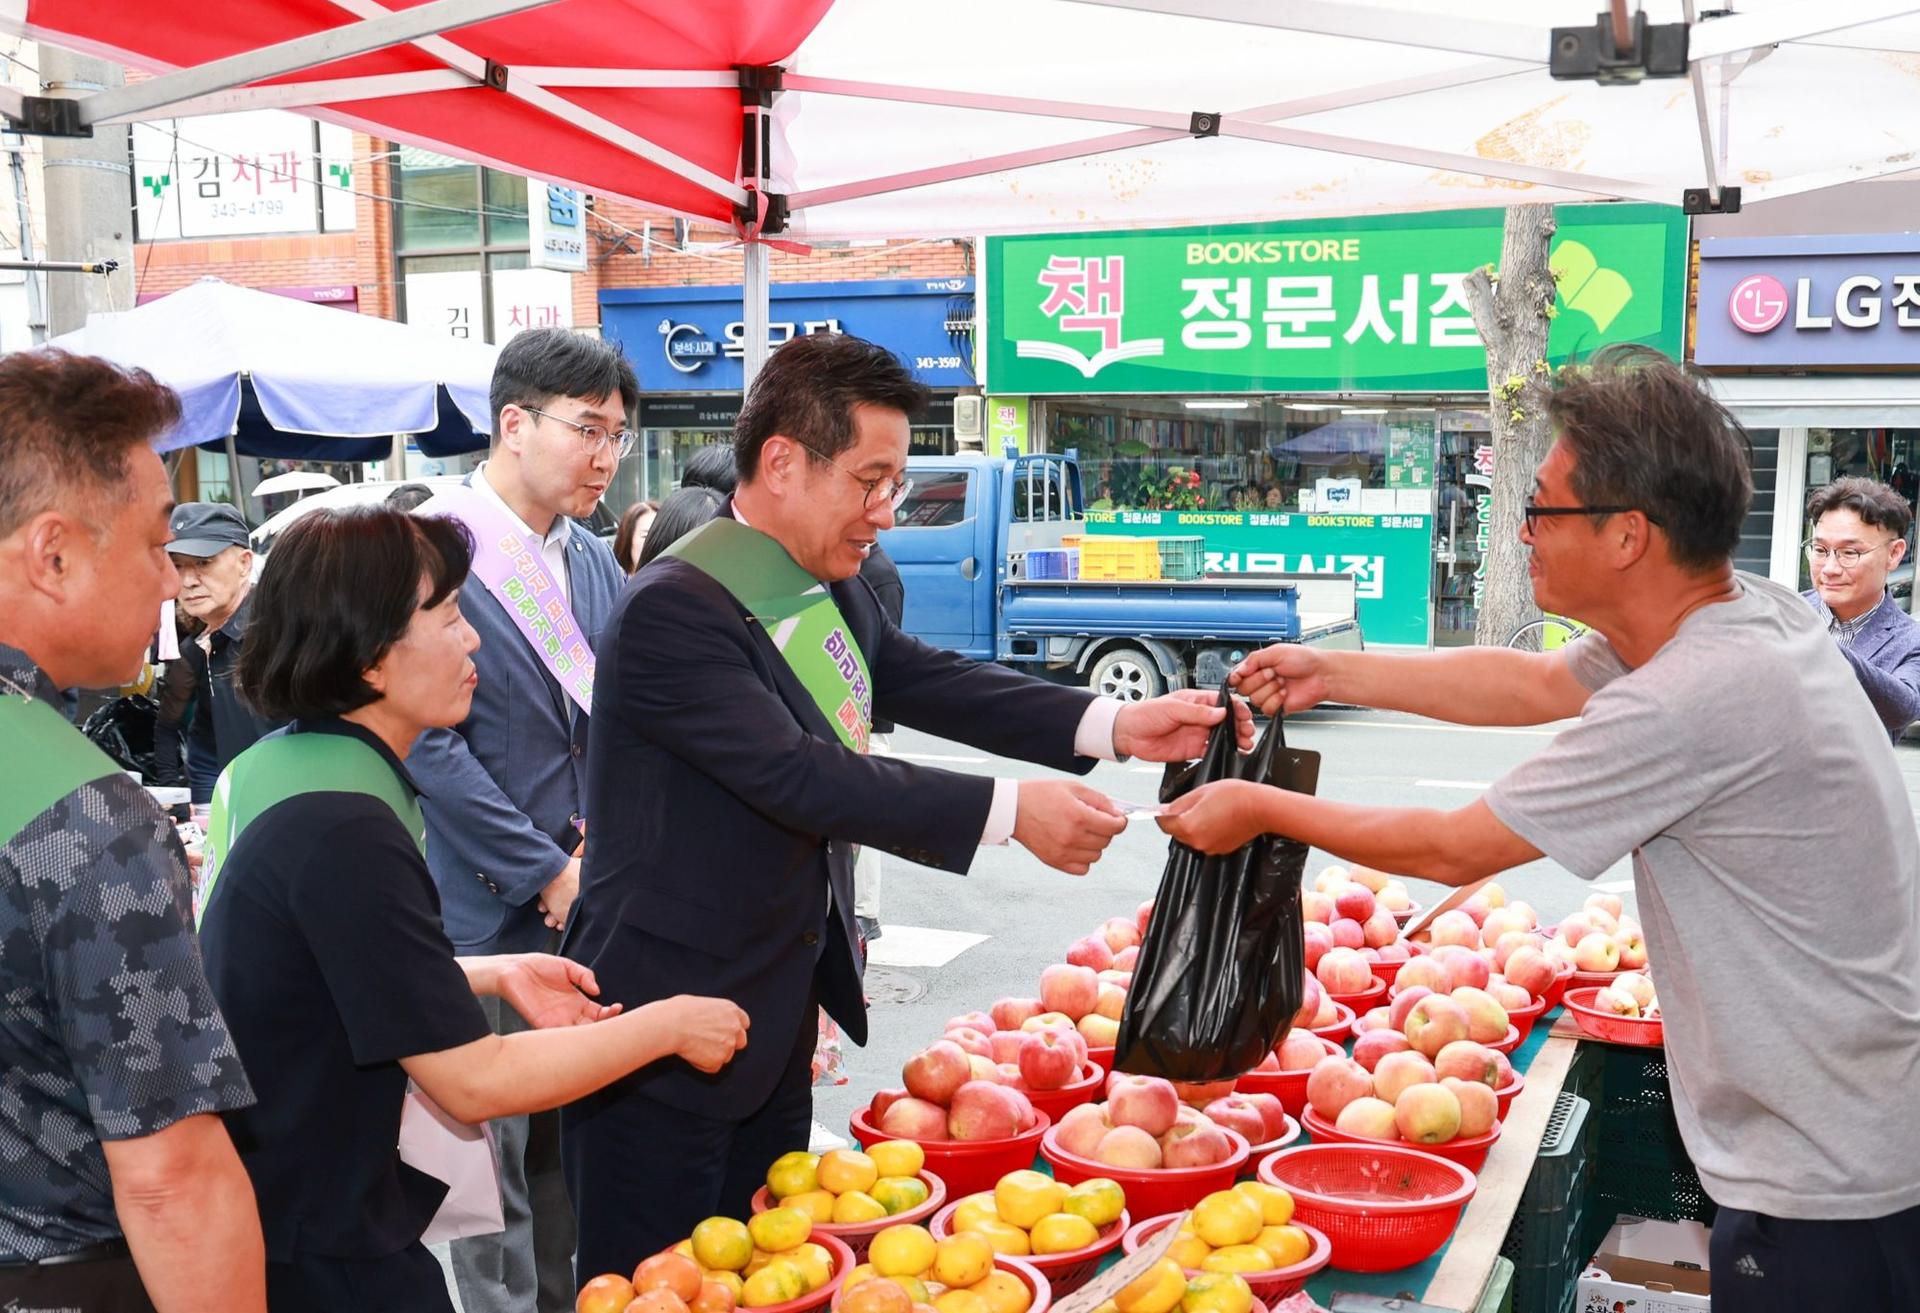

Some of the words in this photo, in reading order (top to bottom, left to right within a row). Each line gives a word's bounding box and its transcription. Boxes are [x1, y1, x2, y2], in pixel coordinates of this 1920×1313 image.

[211, 201, 283, 218] 343-4799
[1187, 239, 1360, 265] BOOKSTORE
[1037, 254, 1124, 350] 책
[1180, 273, 1487, 349] 정문서점
[447, 307, 469, 339] 김
[916, 357, 961, 369] 343-3597
[1122, 512, 1162, 524] 정문서점
[1178, 513, 1243, 525] BOOKSTORE
[1249, 514, 1290, 526] 정문서점
[1307, 516, 1375, 528] BOOKSTORE
[1381, 516, 1424, 529] 정문서점
